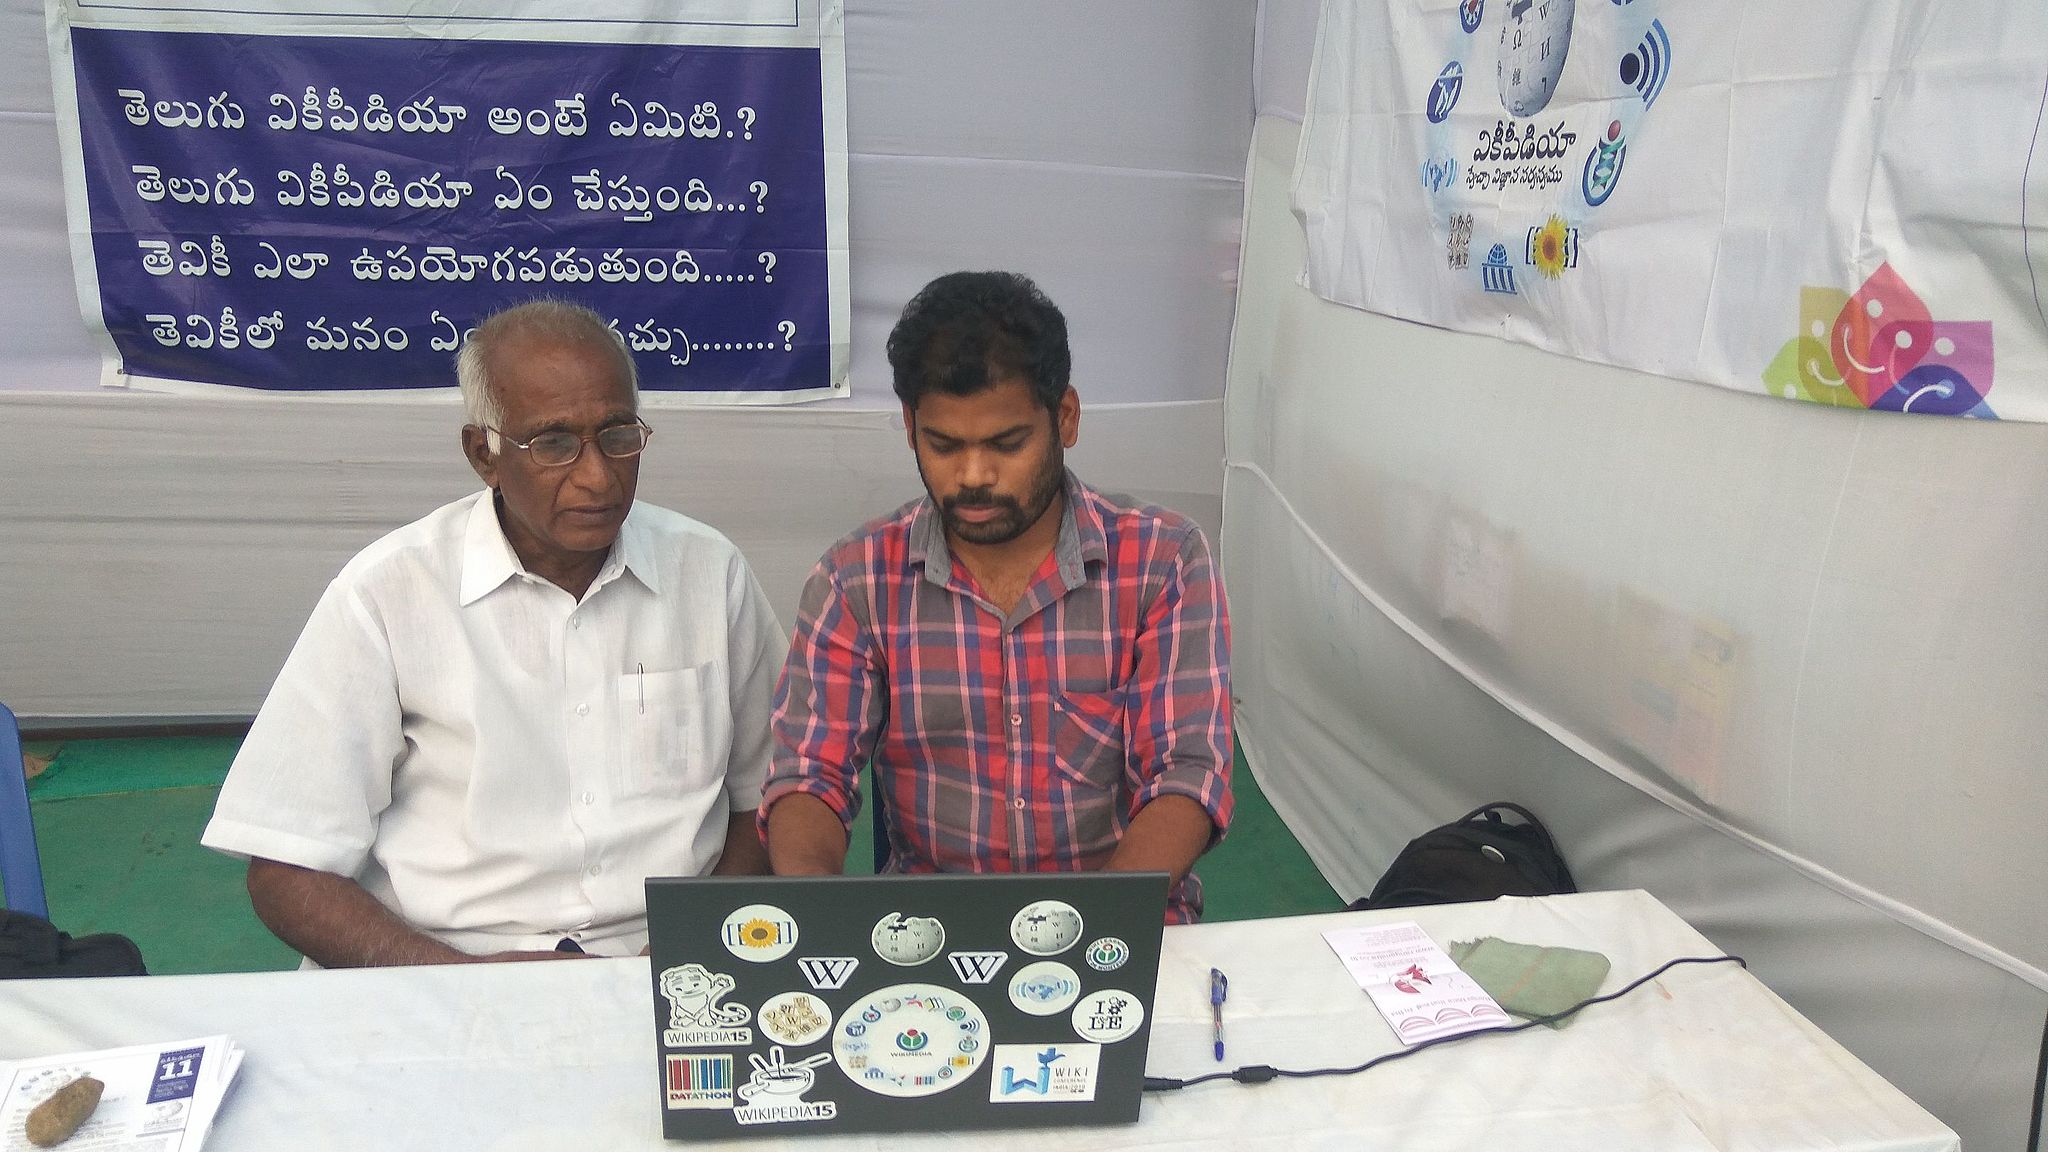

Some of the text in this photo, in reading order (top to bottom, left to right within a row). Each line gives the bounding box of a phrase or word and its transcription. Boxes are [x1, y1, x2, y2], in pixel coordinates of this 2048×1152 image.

[118, 86, 756, 140] తెలుగు వికీపీడియా అంటే ఏమిటి.?
[1473, 120, 1577, 161] వికీపీడియా
[132, 162, 768, 222] తెలుగు వికీపీడియా ఏం చేస్తుంది...?
[138, 235, 231, 277] తెవికీ
[253, 242, 329, 280] ఎలా
[145, 306, 284, 349] తెవికీలో
[306, 316, 409, 351] మనం
[668, 1031, 747, 1043] WIKIPEDIA15
[159, 1059, 194, 1081] 11
[1055, 1067, 1088, 1077] WIKI
[670, 1091, 732, 1100] DATATHON
[738, 1105, 833, 1122] WIKIPEDIA15
